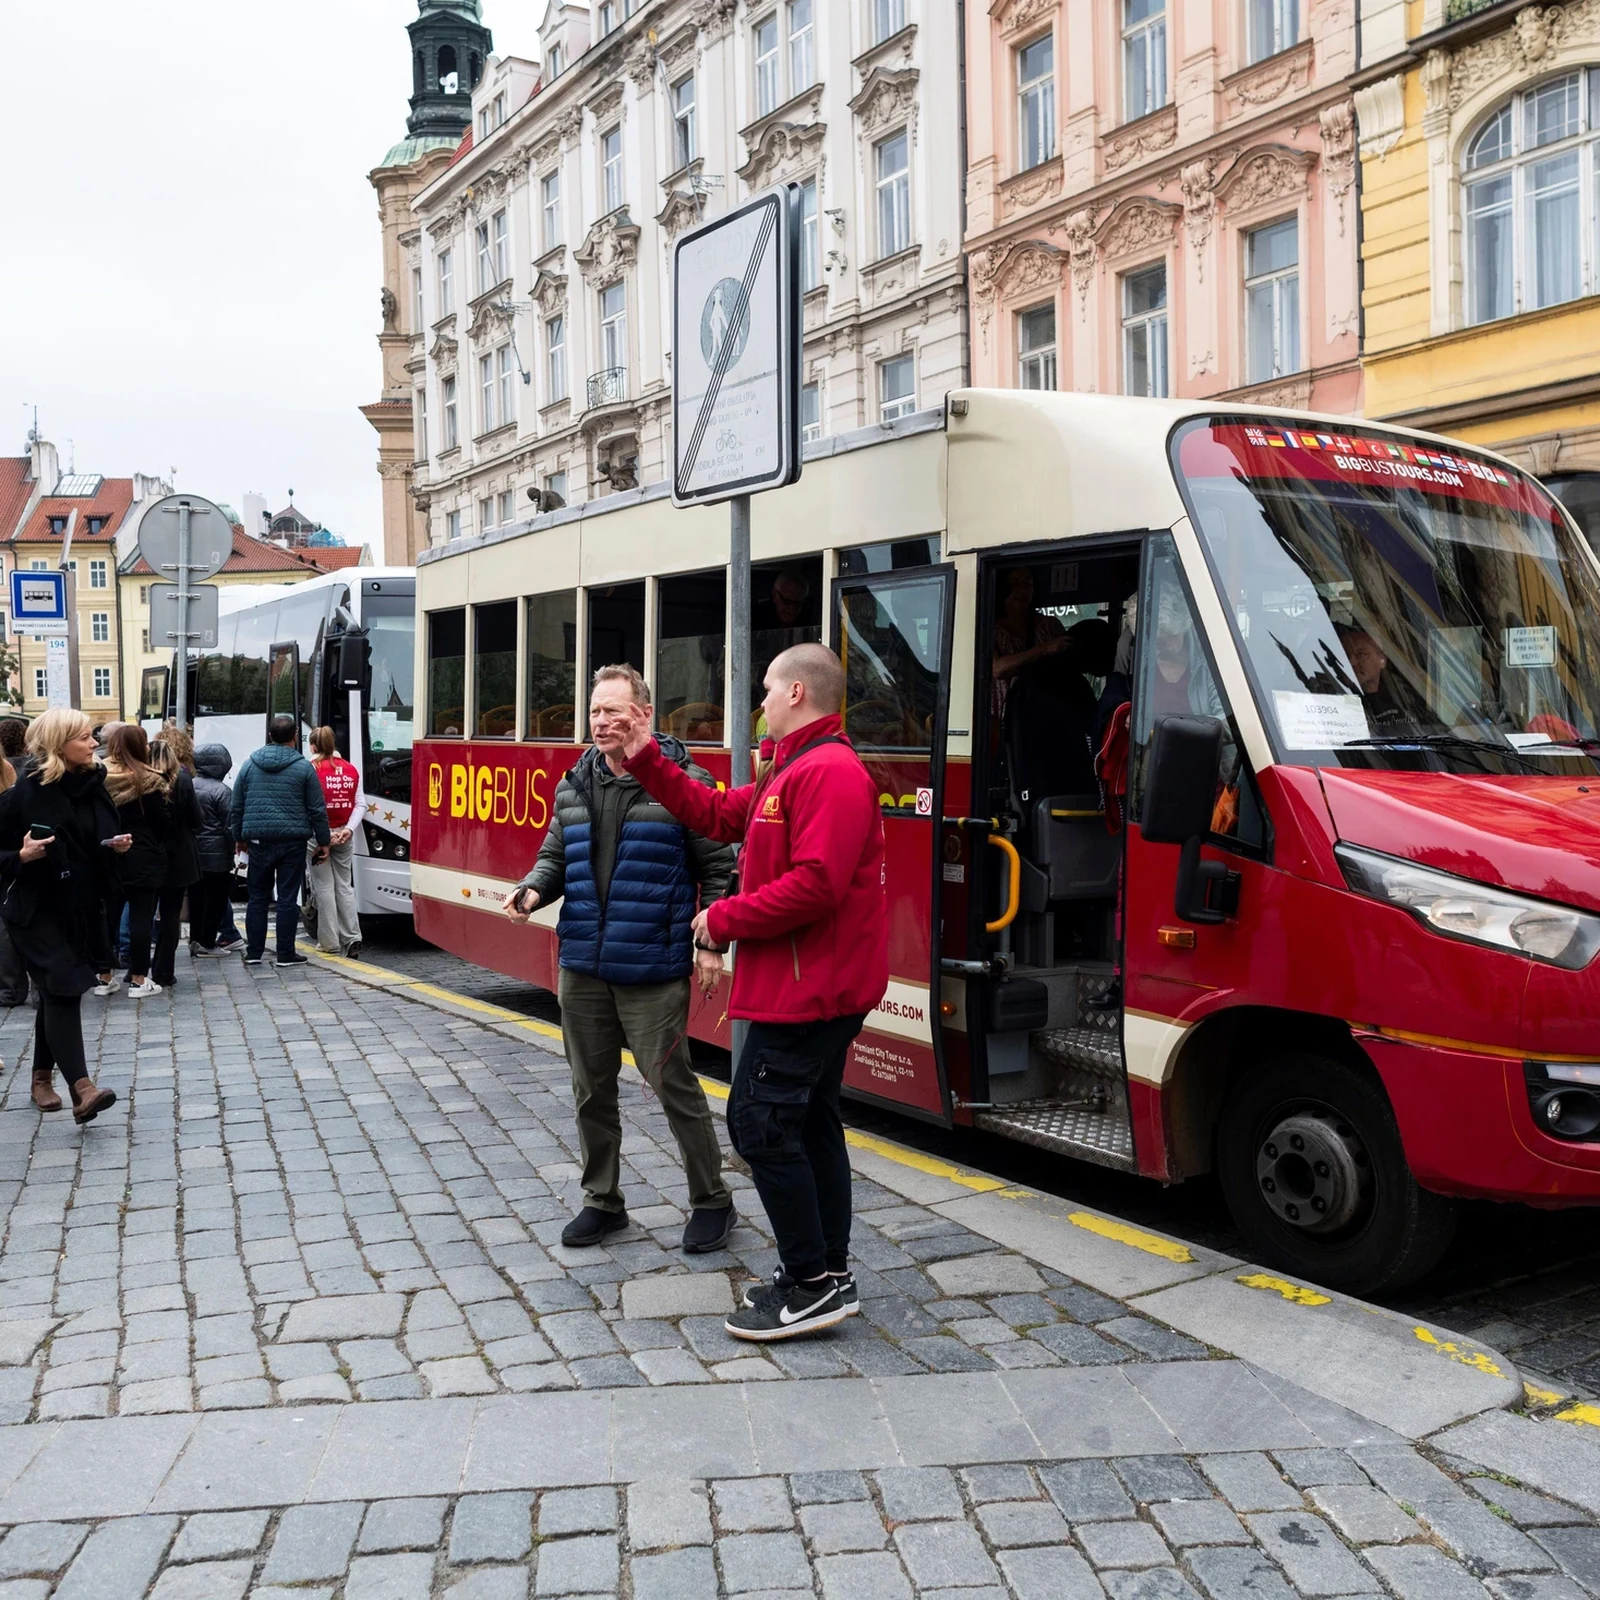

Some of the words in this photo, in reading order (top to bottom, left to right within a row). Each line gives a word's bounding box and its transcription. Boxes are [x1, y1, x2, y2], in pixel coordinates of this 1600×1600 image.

[1334, 455, 1463, 487] BIGBUSTOURS.COM
[50, 640, 65, 648] 194
[1304, 705, 1339, 715] 103904
[451, 764, 547, 829] BIGBUS
[853, 1041, 875, 1055] Premiant
[876, 1047, 885, 1060] City
[885, 1050, 898, 1061] Tour
[881, 1062, 894, 1072] Praha
